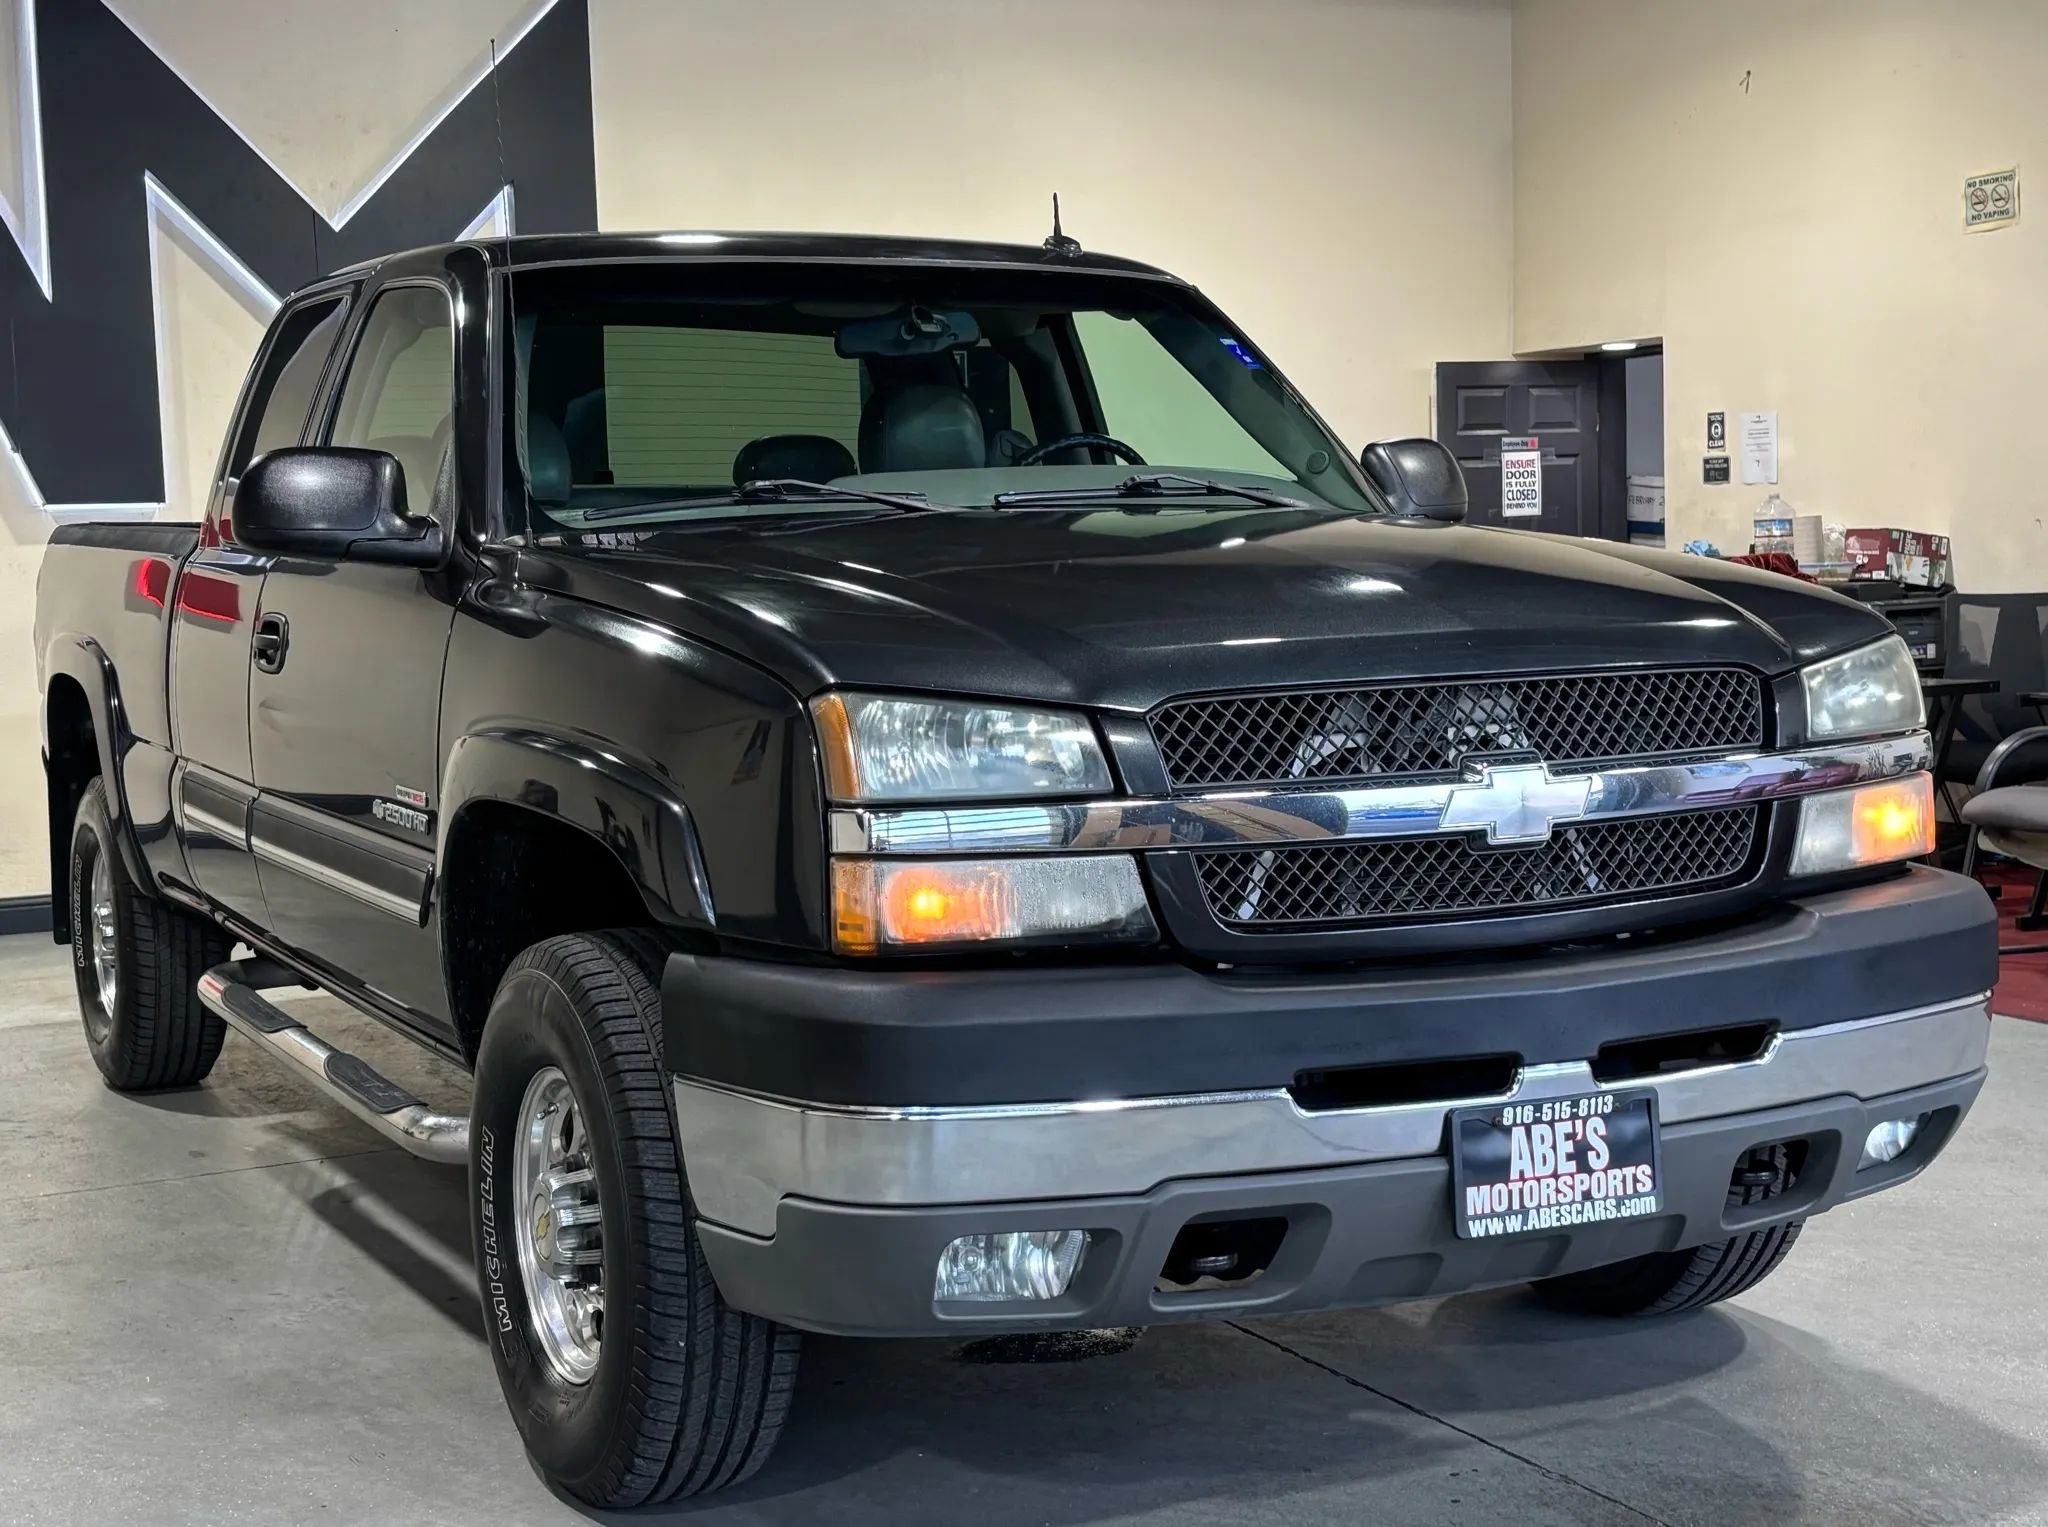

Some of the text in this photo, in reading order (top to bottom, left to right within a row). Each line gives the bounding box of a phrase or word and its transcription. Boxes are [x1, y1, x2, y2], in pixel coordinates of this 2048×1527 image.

[1979, 174, 2013, 187] SMOKING
[1971, 208, 2009, 221] NO VAPING
[1505, 459, 1536, 469] ENSURE
[1506, 470, 1536, 480] DOOR
[1515, 480, 1537, 488] FULLY
[1506, 489, 1537, 501] CLOSED
[73, 854, 85, 967] MICHELIN
[1502, 1094, 1613, 1126] 916-515-8113
[1509, 1116, 1610, 1180] ABE'S
[1466, 1164, 1653, 1216] MOTORSPORTS
[481, 1125, 513, 1332] MICHELIN
